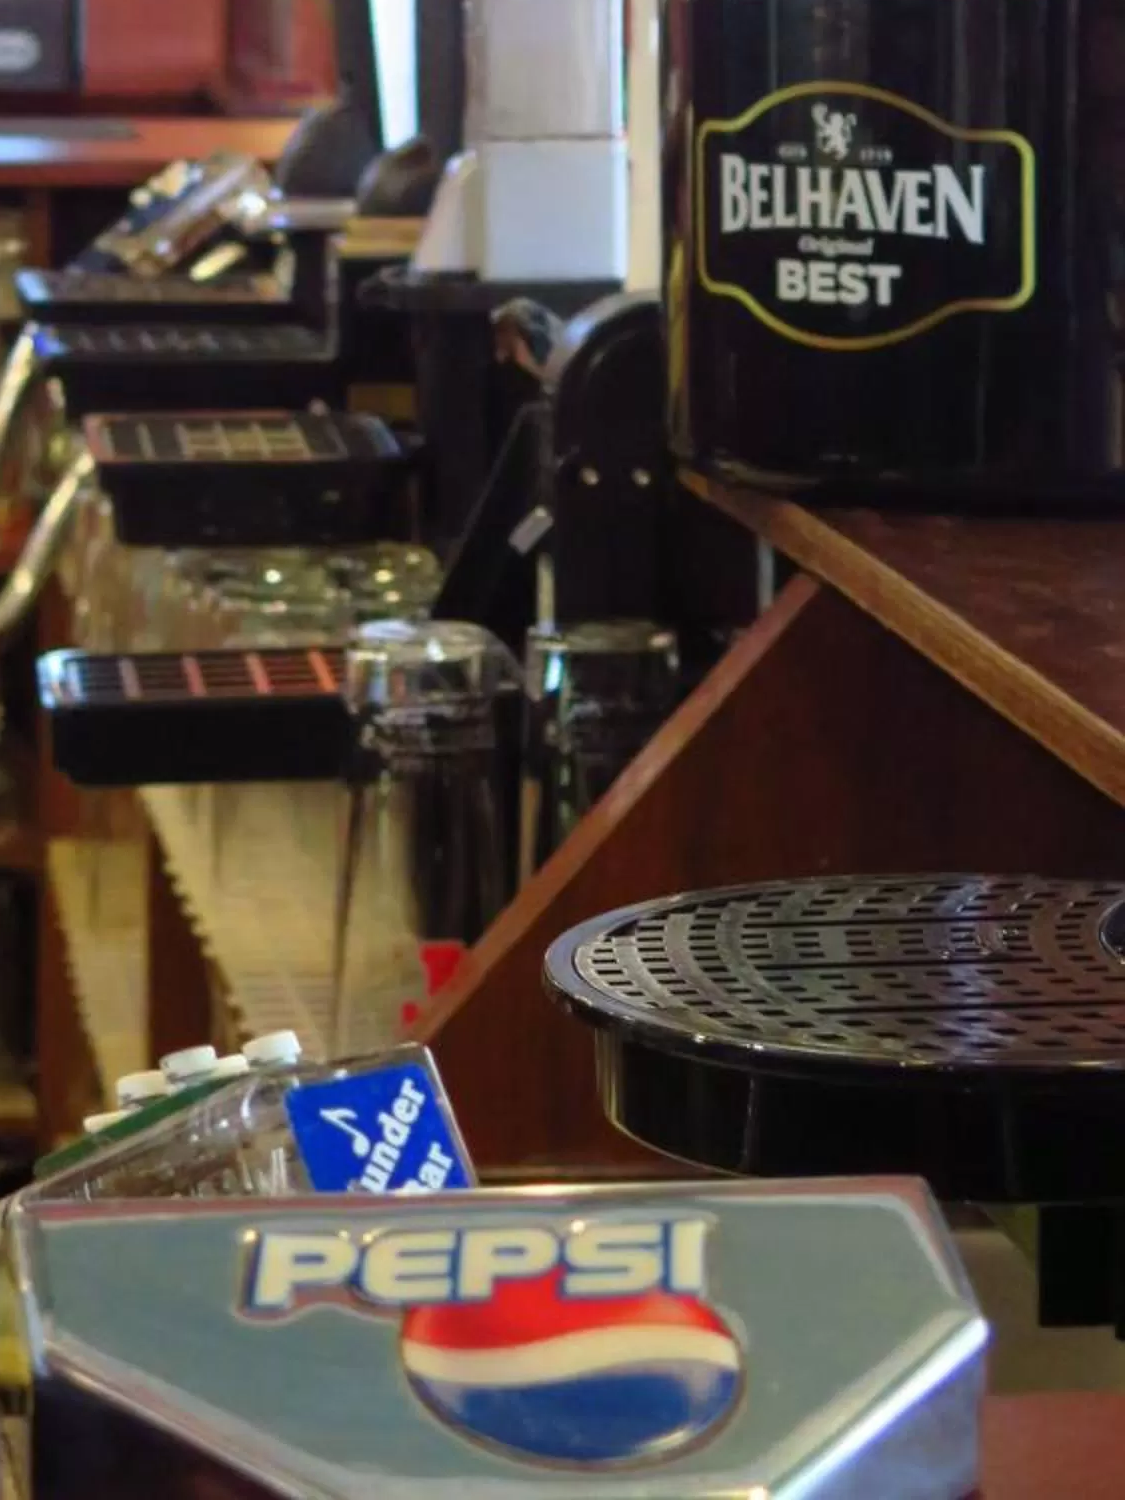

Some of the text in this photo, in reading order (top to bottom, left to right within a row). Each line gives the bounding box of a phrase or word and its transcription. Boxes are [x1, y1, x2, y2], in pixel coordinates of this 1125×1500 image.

[720, 153, 985, 245] BELHAVEN
[777, 258, 903, 306] BEST
[349, 1077, 425, 1194] under
[243, 1219, 707, 1310] PEPSI
